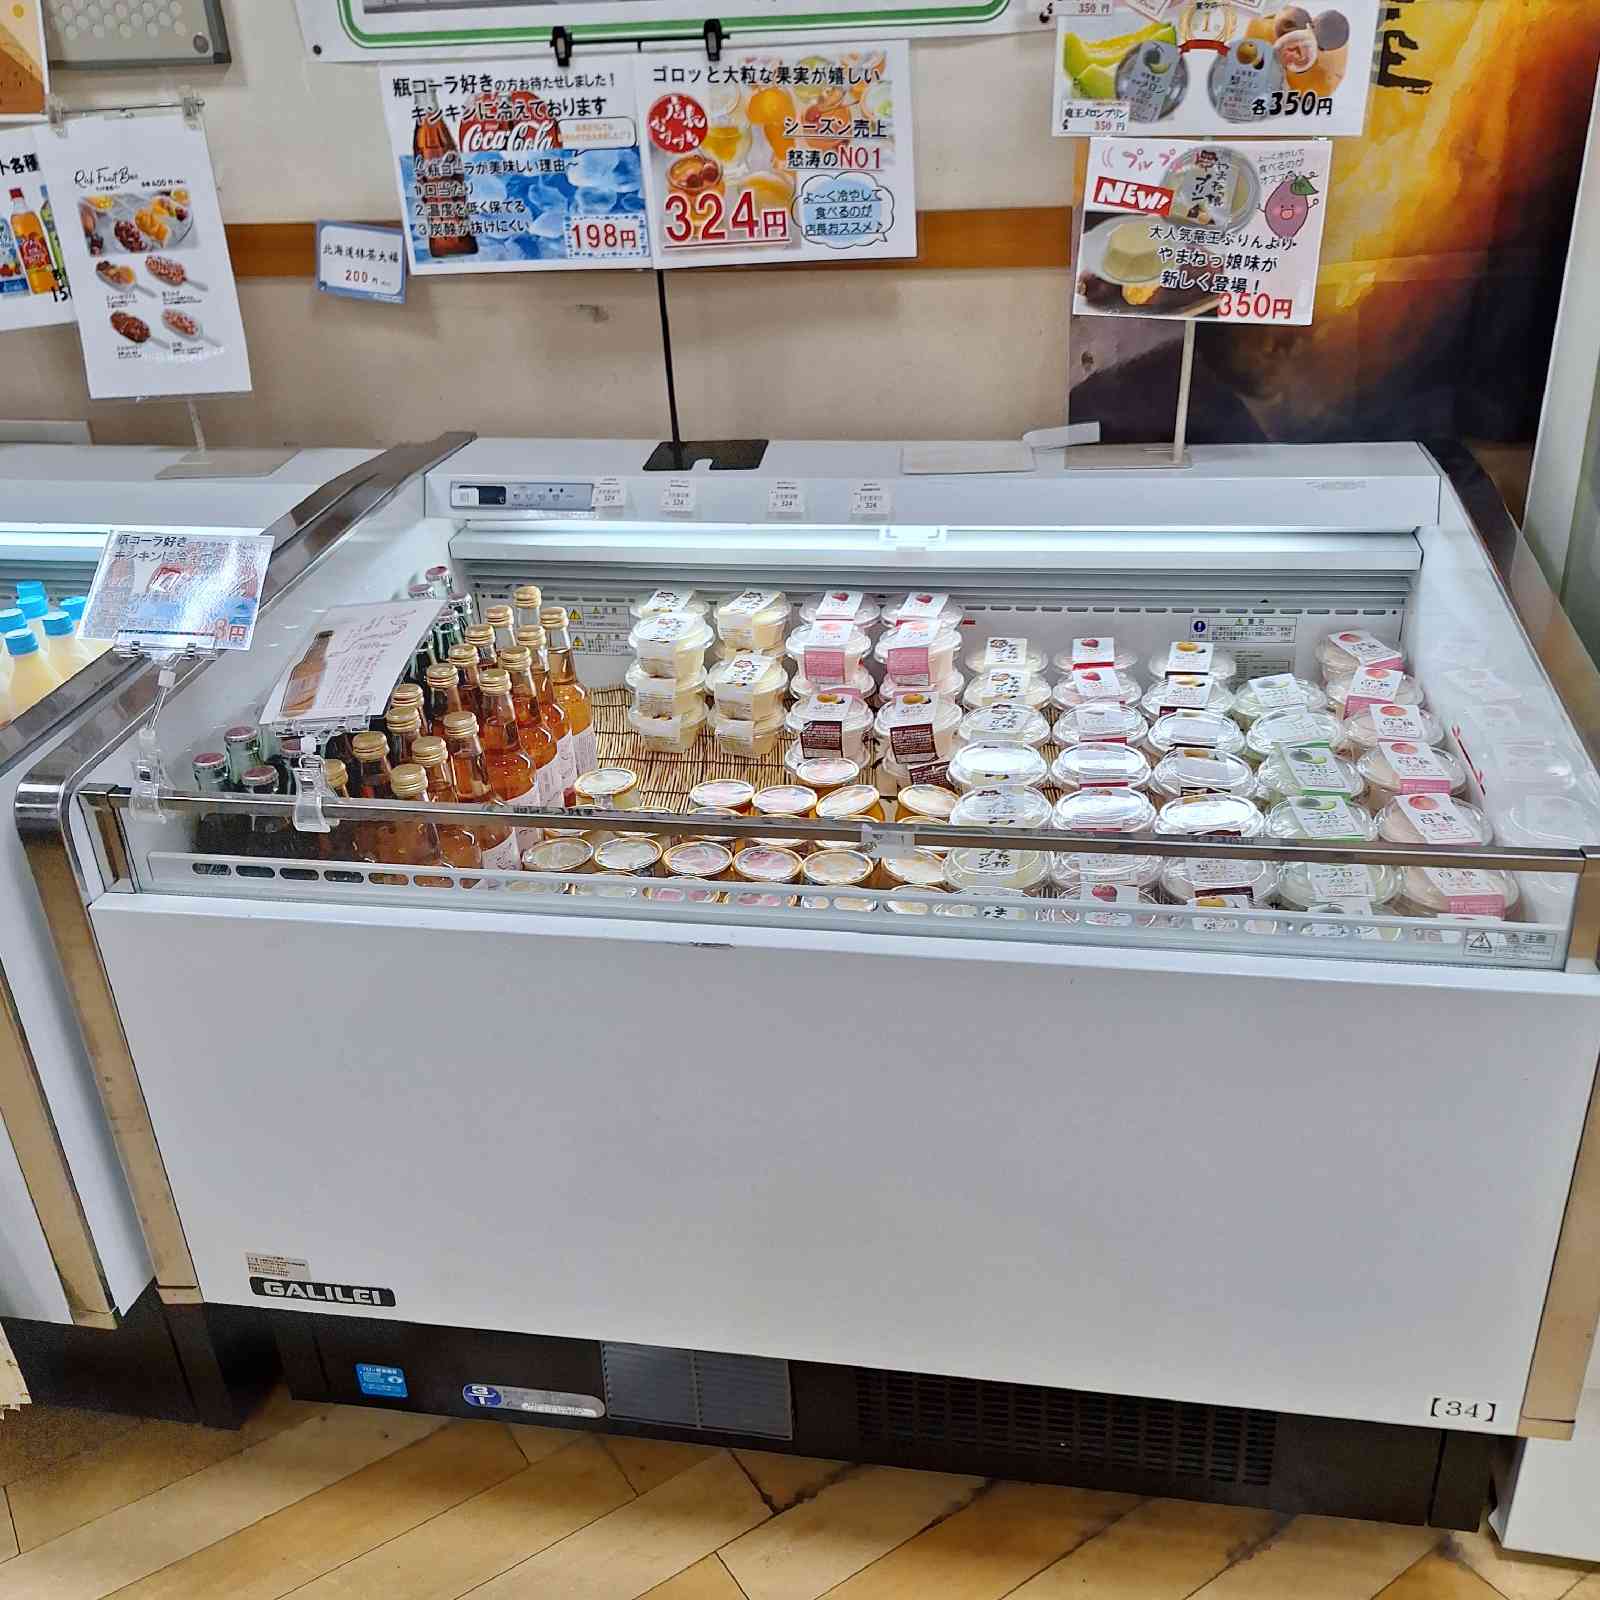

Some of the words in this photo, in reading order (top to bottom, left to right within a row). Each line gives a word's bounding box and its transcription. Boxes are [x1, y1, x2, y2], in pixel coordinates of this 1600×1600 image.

[411, 97, 607, 123] キンキンに冷えております
[784, 117, 888, 138] シーズン売上
[1098, 181, 1170, 210] NEW!
[664, 191, 789, 242] 324円
[571, 223, 637, 249] 198円
[1217, 293, 1294, 320] 350円
[262, 1280, 382, 1305] GALILEI
